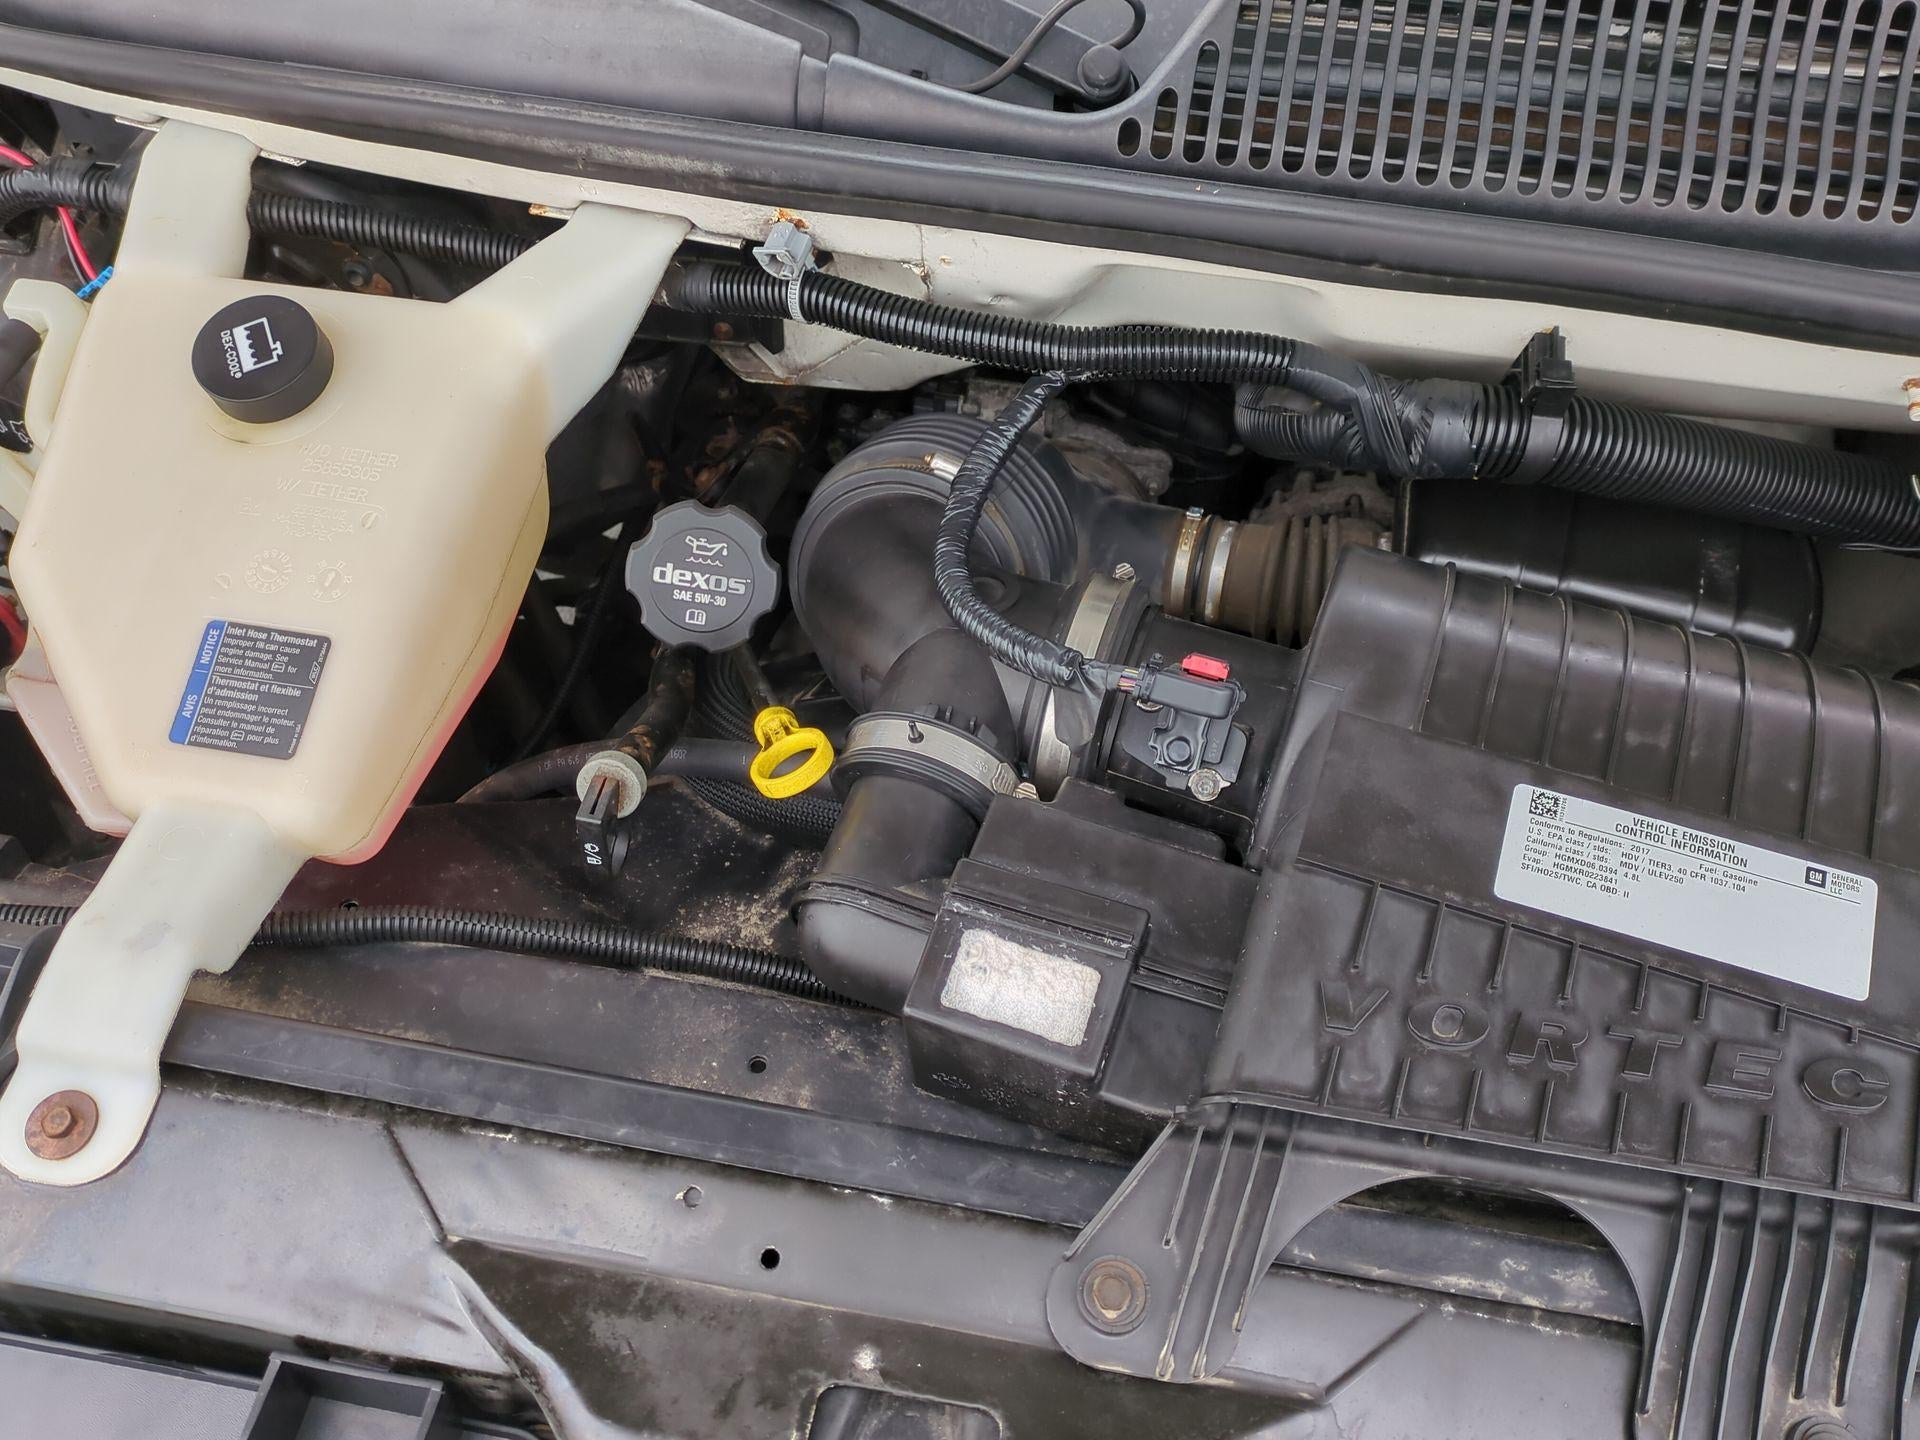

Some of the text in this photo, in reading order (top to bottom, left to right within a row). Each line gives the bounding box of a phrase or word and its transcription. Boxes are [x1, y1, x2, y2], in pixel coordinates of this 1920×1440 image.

[673, 589, 727, 607] SAE 5W-30
[223, 637, 258, 648] Improper
[266, 643, 278, 651] can
[280, 646, 300, 654] cause
[227, 626, 318, 647] Inlet Hose Thermostat
[201, 629, 220, 664] NOTICE
[220, 647, 289, 662] engine damage. See
[215, 666, 274, 680] more information.
[217, 656, 297, 674] Service Manual for
[207, 686, 259, 702] d'admission
[211, 676, 301, 697] Thermostat et flexible
[183, 694, 197, 718] AVIS
[204, 697, 288, 715] Un remplissage incorrect
[197, 716, 230, 727] Consulter
[239, 722, 265, 732] manuel
[266, 726, 275, 734] de
[200, 707, 216, 716] peut
[217, 709, 262, 723] endommager
[271, 716, 294, 726] moteur.
[191, 734, 238, 748] d'information.
[194, 726, 279, 745] réparation pour plus
[1530, 818, 1650, 855] Conforms to Regulations: 2017
[1632, 817, 1736, 854] VEHICLE EMISSION
[1615, 823, 1748, 868] CONTROL INFORMATION
[1522, 854, 1544, 865] Evap:
[1524, 844, 1550, 857] Group:
[1623, 872, 1641, 883] 4.8L
[1526, 836, 1562, 851] California
[1565, 844, 1585, 856] class
[1586, 850, 1591, 858] /
[1619, 860, 1640, 872] MDV
[1648, 868, 1684, 885] ULEV250
[1528, 827, 1544, 837] U.S.
[1547, 832, 1563, 841] EPA
[1565, 836, 1585, 848] class
[1621, 852, 1640, 862] HDV
[1677, 867, 1687, 875] 40
[1690, 871, 1706, 882] CFR
[1710, 876, 1746, 893] 1037.104
[1699, 864, 1758, 886] Fuel: Gasoline
[1809, 870, 1823, 883] GM
[1831, 873, 1863, 887] GENERAL
[1586, 880, 1597, 891] CA
[1600, 884, 1620, 896] OBD:
[1830, 887, 1843, 895] LLC
[1831, 880, 1860, 893] MOTORS
[1320, 979, 1892, 1112] VORTEC
